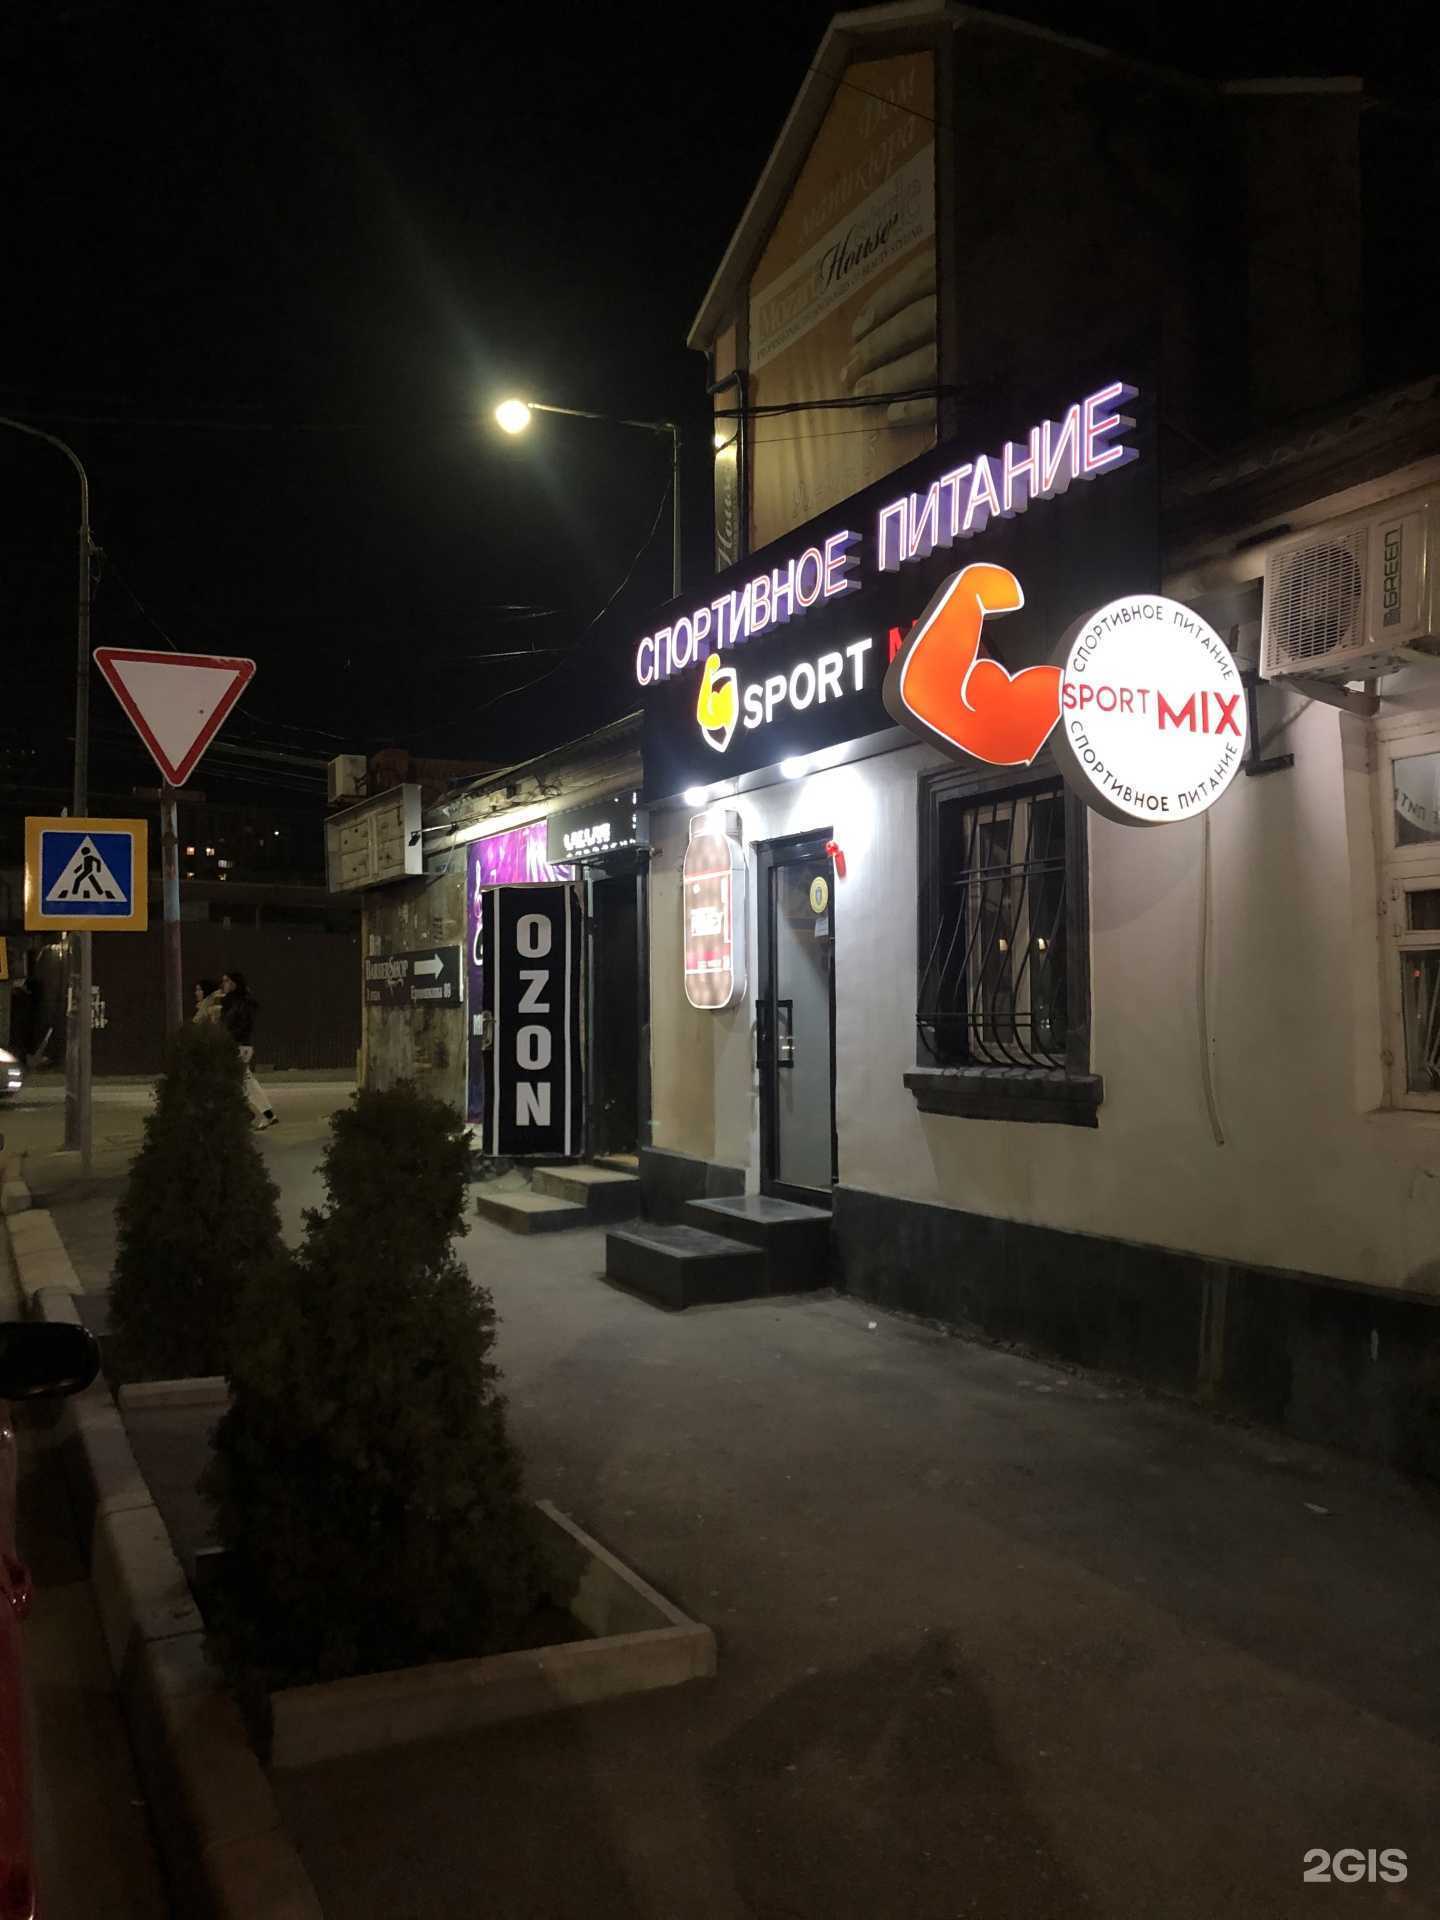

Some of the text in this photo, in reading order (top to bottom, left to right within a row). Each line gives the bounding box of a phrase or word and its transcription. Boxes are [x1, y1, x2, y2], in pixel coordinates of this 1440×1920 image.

[635, 382, 1126, 686] СПОРТИВНОЕ ПИТАНИЕ
[742, 637, 873, 729] SPORT
[1073, 604, 1234, 681] СПОРТИВНОЕ ПИТАНИЕ
[1062, 683, 1242, 737] SPORT MIX
[1070, 720, 1238, 812] СПОРТИВНОЕ ПИТАНИЕ
[516, 913, 552, 1127] OZON
